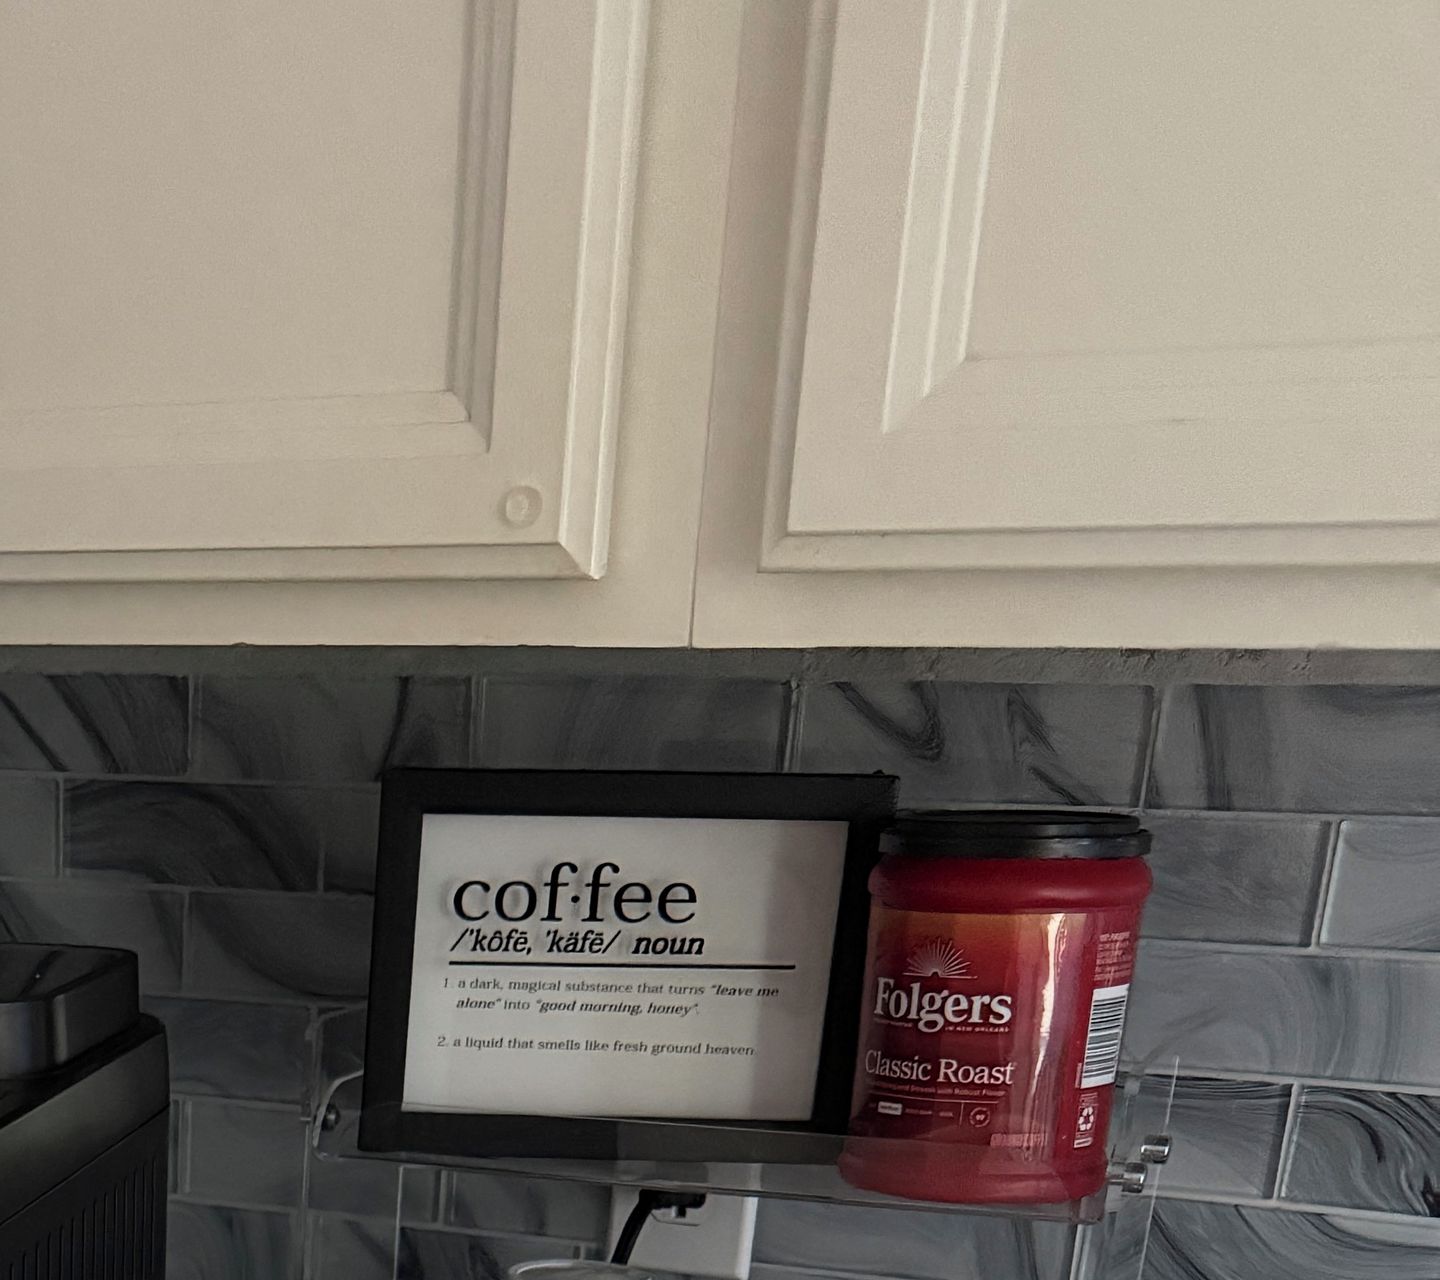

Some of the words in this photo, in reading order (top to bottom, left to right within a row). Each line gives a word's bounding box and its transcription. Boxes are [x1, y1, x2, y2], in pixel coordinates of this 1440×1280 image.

[631, 932, 706, 956] noun
[457, 979, 466, 990] a
[469, 978, 504, 991] dark,
[507, 979, 561, 994] magical
[564, 981, 633, 994] substance
[637, 982, 664, 995] that
[667, 984, 706, 996] turns
[756, 987, 780, 998] me
[503, 999, 531, 1011] into
[578, 1001, 643, 1016] morning,
[873, 976, 1013, 1033] Folgers
[452, 1038, 461, 1048] a
[464, 1036, 504, 1051] liquid
[507, 1037, 534, 1050] that
[537, 1038, 581, 1051] smells
[584, 1039, 610, 1052] like
[612, 1040, 648, 1053] fresh
[650, 1042, 702, 1056] ground
[864, 1049, 932, 1081] Classic
[935, 1058, 1016, 1085] Roast
